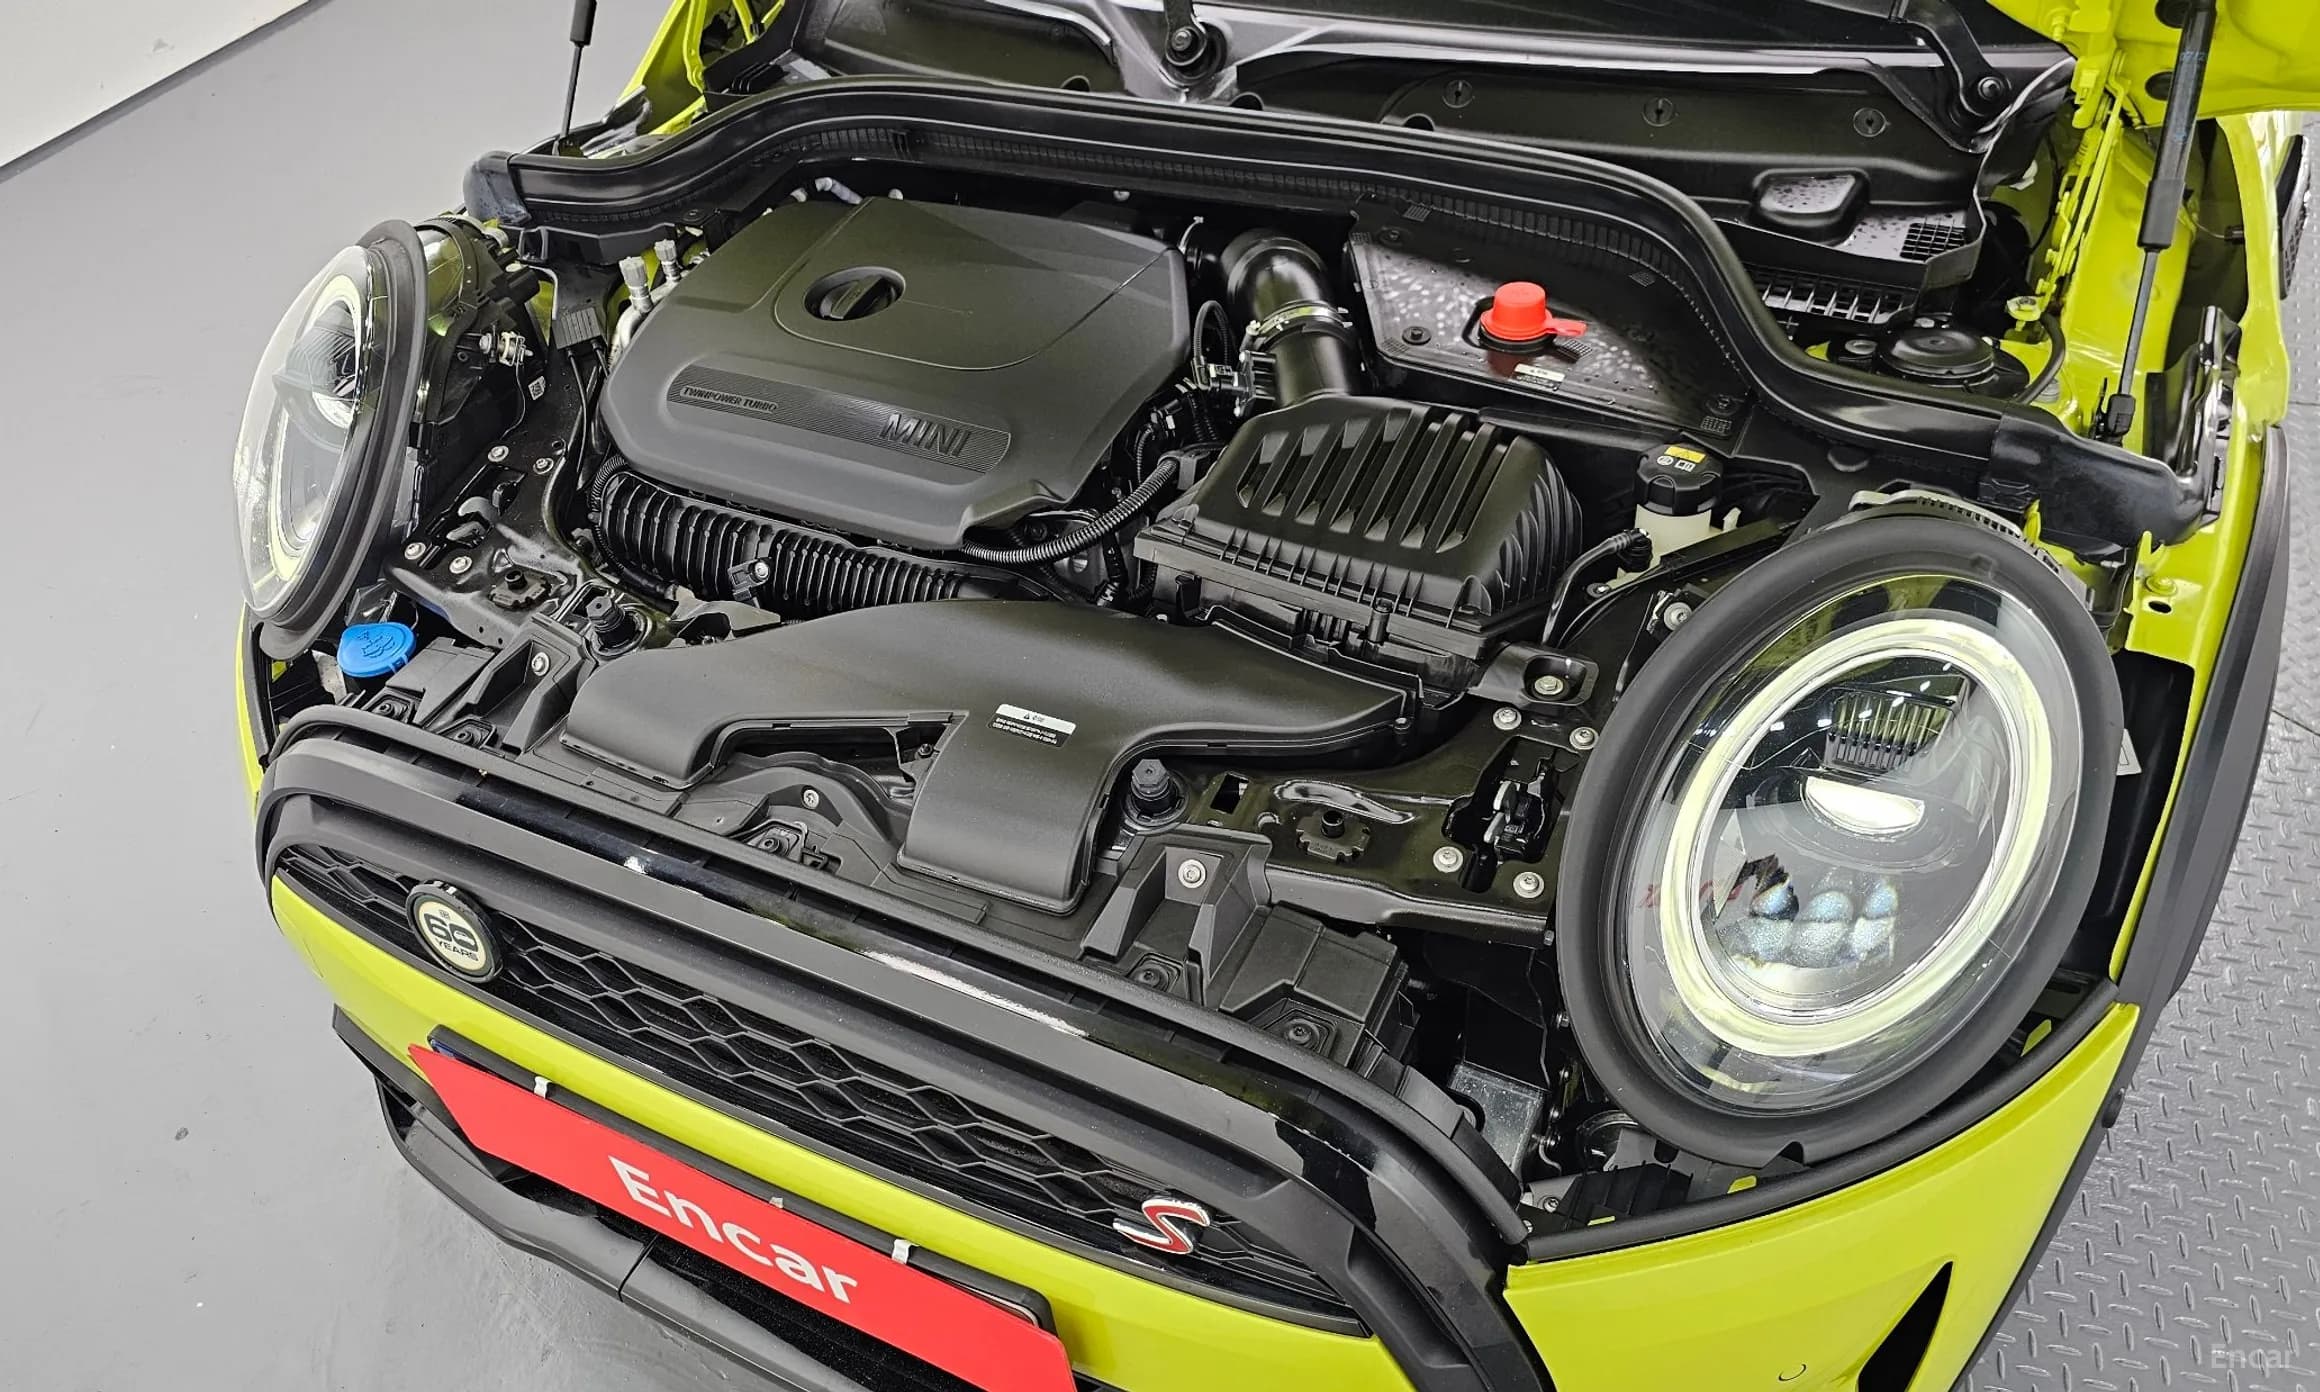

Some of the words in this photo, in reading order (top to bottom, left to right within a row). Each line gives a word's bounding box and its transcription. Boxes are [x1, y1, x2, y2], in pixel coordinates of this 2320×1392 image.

[682, 386, 742, 405] TWINPOWER
[742, 398, 777, 412] TURBO
[879, 414, 972, 457] MINI
[424, 913, 479, 952] 60
[434, 938, 479, 962] YEARS
[607, 1154, 858, 1304] Encar
[1113, 1198, 1211, 1255] S
